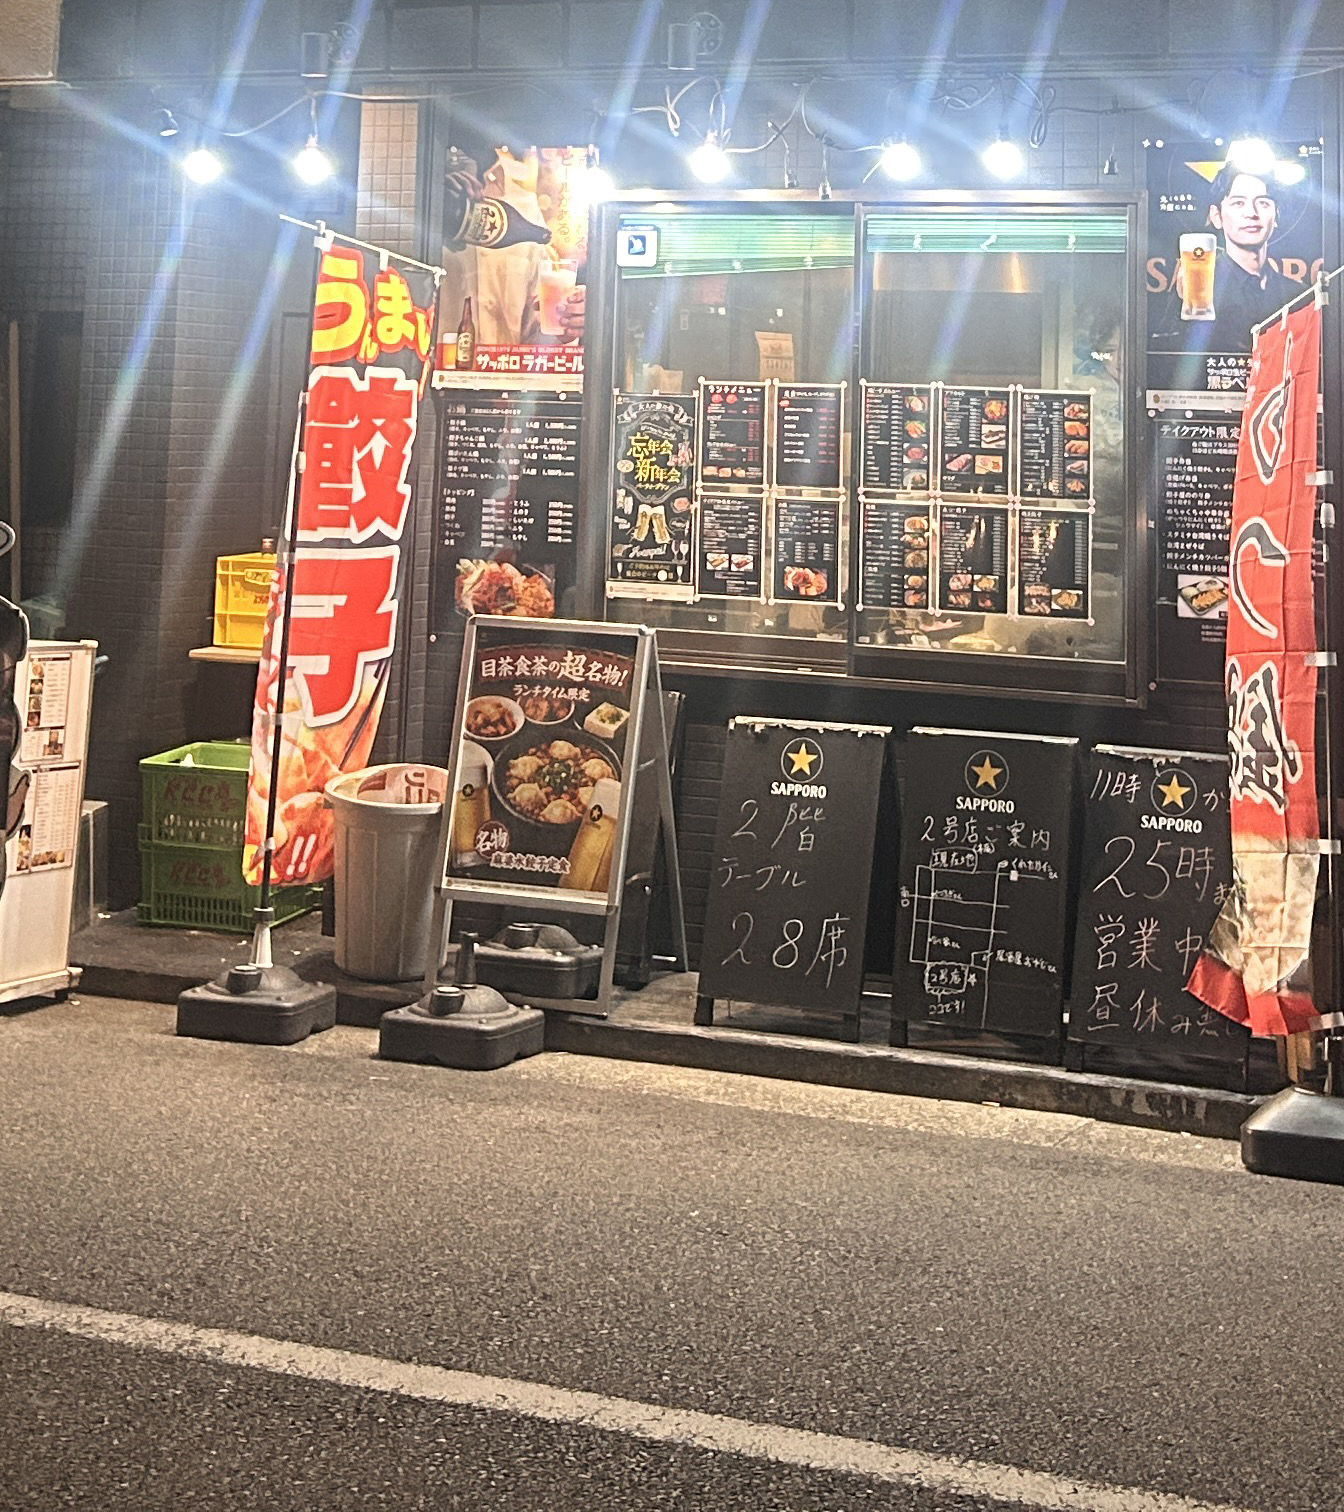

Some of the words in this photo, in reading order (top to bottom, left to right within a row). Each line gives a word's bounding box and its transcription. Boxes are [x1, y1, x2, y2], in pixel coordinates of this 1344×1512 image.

[476, 354, 520, 370] サッポロ
[522, 355, 584, 372] ラガービール
[1206, 376, 1251, 390] 黒ラベ
[626, 432, 674, 459] 忘年会
[634, 456, 682, 483] 新年会
[481, 649, 629, 687] 目茶食茶の超名物!
[512, 683, 591, 702] ランチタイム限定
[770, 781, 828, 799] SAPPORO
[955, 796, 1015, 814] SAPPORO
[730, 799, 828, 852] 2階
[920, 814, 1051, 851] 2号店ご案内
[1140, 814, 1204, 834] SAPPORO
[475, 827, 509, 851] 名物
[931, 851, 977, 868] 現在地
[717, 856, 807, 891] テーブル
[721, 910, 852, 989] 28席
[1093, 913, 1204, 977] 営業中
